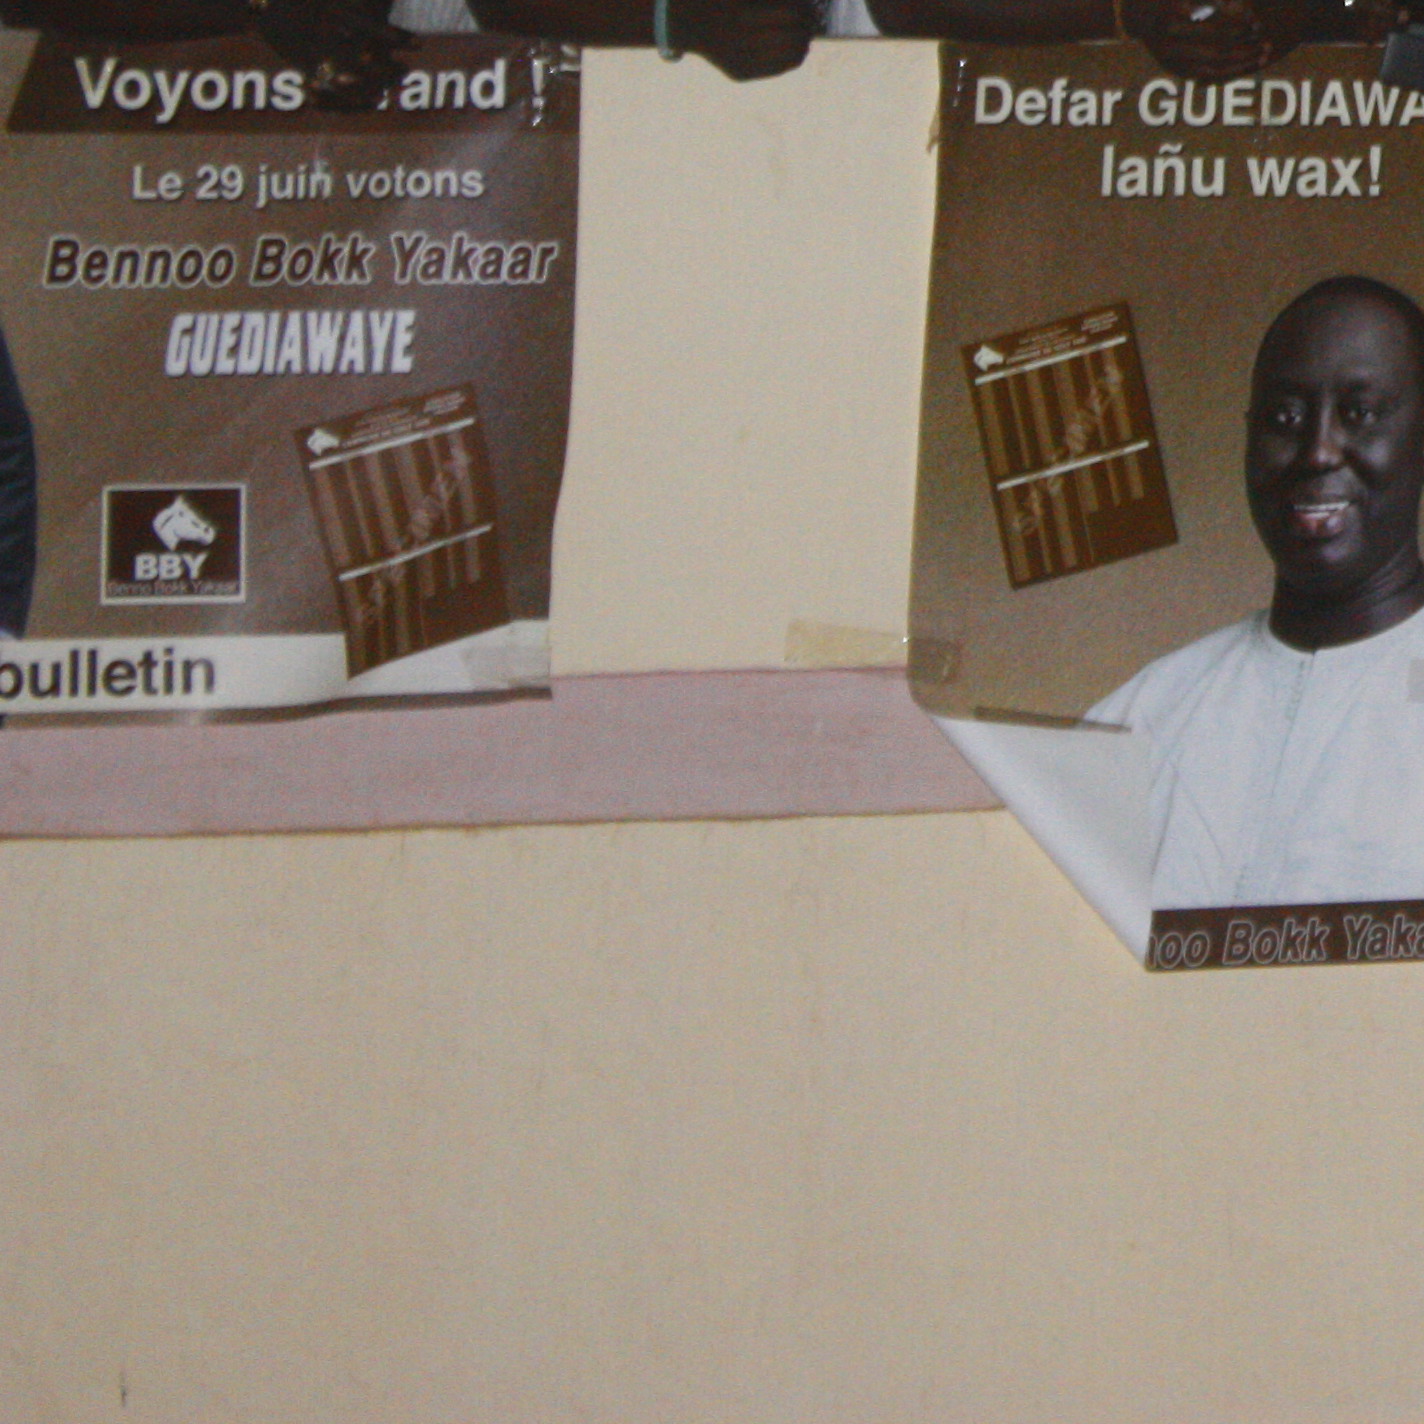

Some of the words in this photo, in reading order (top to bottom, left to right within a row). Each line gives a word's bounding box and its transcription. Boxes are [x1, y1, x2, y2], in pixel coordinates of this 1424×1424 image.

[75, 57, 305, 124] Voyons
[975, 77, 1122, 127] Defar
[132, 165, 182, 200] Le
[196, 164, 244, 200] 29
[255, 163, 331, 208] juin
[346, 164, 485, 199] votons
[1247, 145, 1382, 197] wax!
[43, 232, 235, 288] Bennoo
[249, 232, 376, 287] Bokk
[390, 230, 560, 285] Yakaar
[165, 310, 416, 377] GUEDIAWAYE
[134, 551, 208, 581] BBY
[1222, 916, 1330, 965] Bokk
